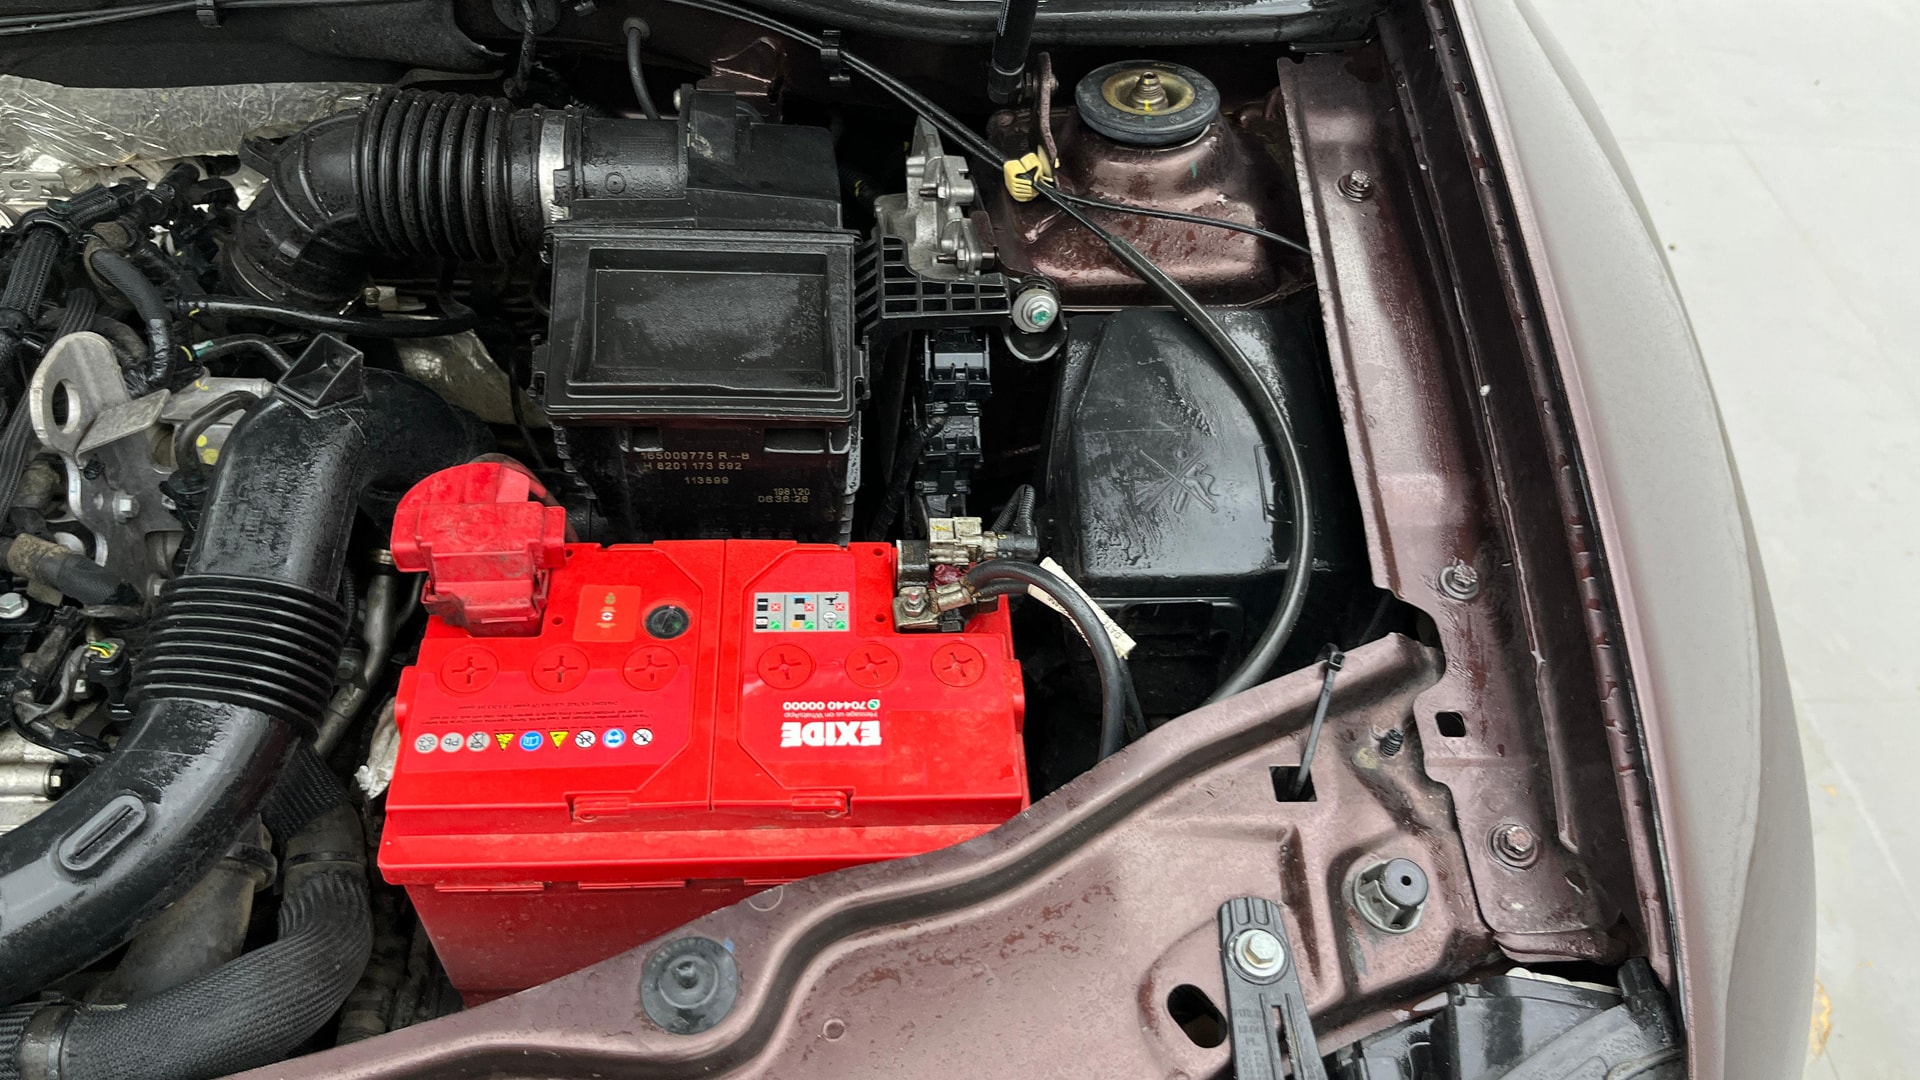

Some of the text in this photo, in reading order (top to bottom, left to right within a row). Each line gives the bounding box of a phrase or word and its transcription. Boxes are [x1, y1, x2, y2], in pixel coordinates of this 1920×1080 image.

[657, 461, 688, 470] 8201
[692, 461, 714, 470] 173
[718, 461, 743, 470] 592
[783, 701, 867, 710] 70440 00000
[784, 710, 824, 719] WhatsApp
[780, 721, 882, 748] EXIDE
[444, 737, 460, 747] Pb
